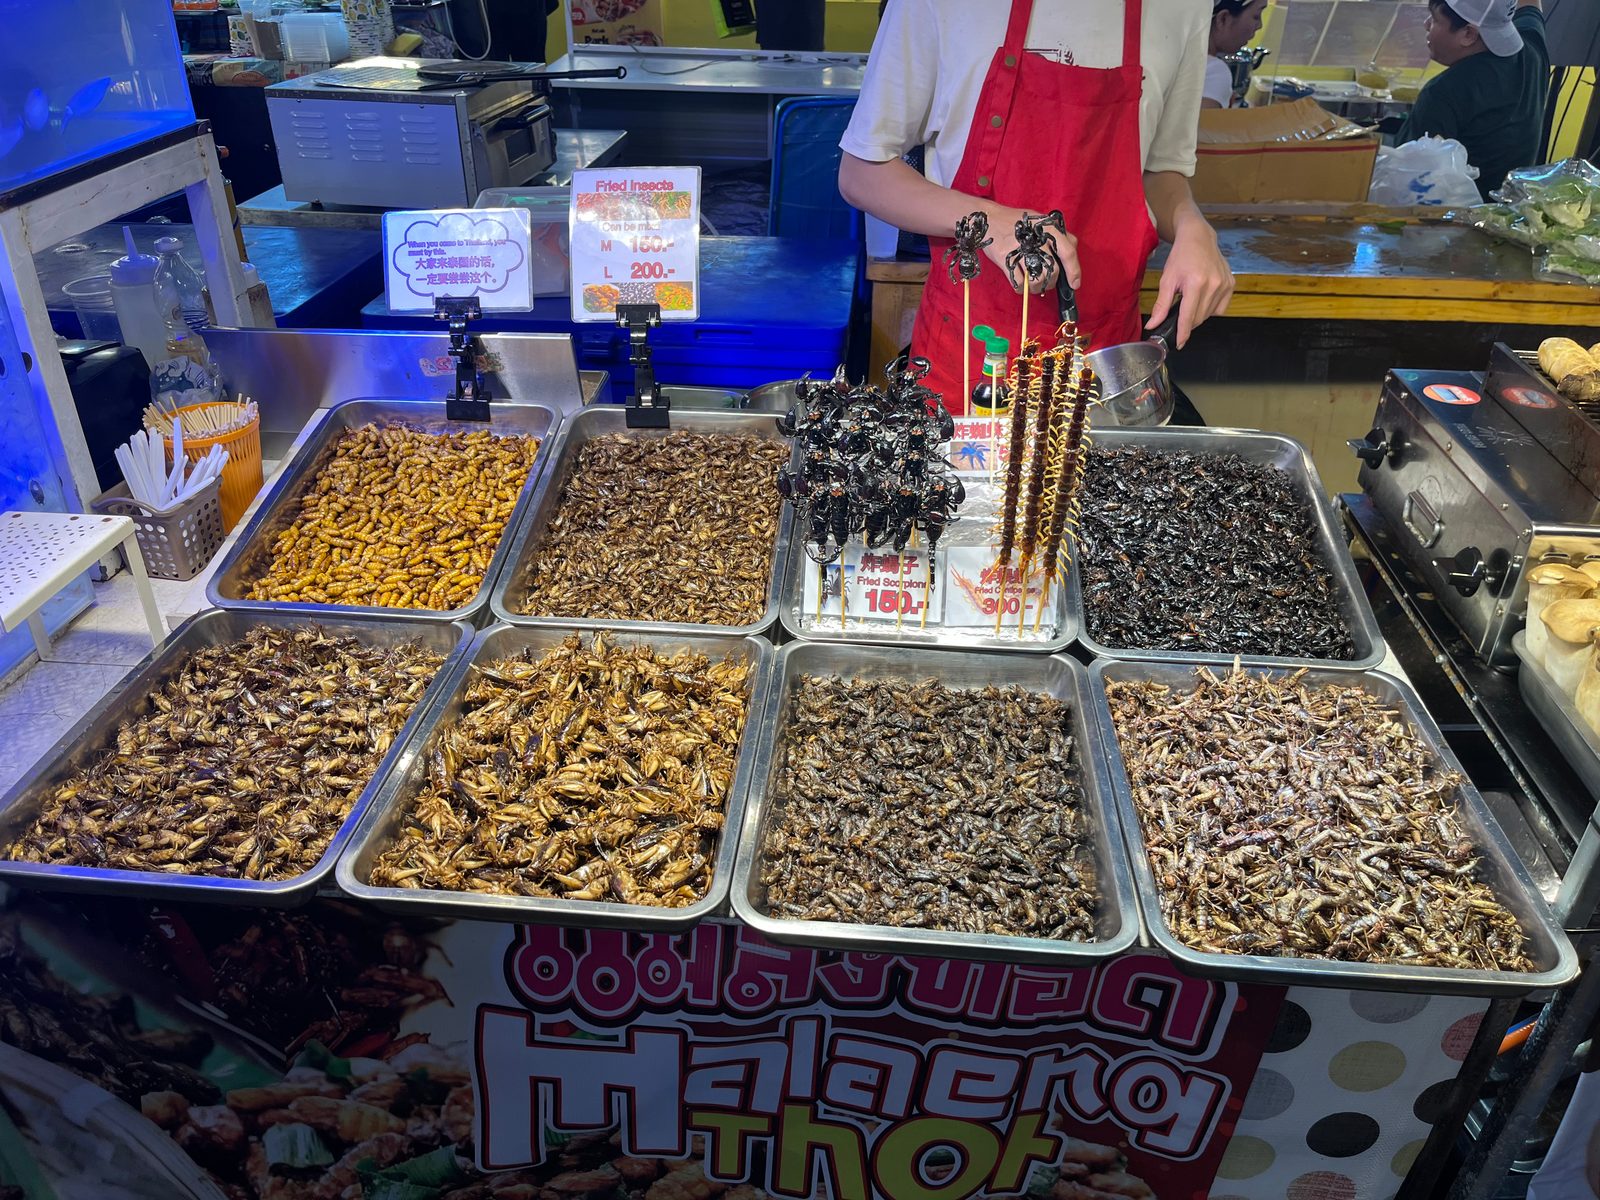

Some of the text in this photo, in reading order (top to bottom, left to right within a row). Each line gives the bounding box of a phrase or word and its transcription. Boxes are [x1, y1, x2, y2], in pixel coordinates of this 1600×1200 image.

[595, 179, 674, 192] Fried Insects
[602, 222, 621, 232] Can
[623, 221, 635, 231] be
[427, 241, 438, 249] you
[600, 235, 675, 253] M 150.-
[604, 262, 675, 279] L 200.-
[857, 575, 927, 589] Fried Scopions
[974, 585, 1036, 596] Fried Cntipees
[865, 588, 929, 615] 150.-
[982, 597, 1033, 615] 300-
[476, 1005, 1234, 1173] Malaeng
